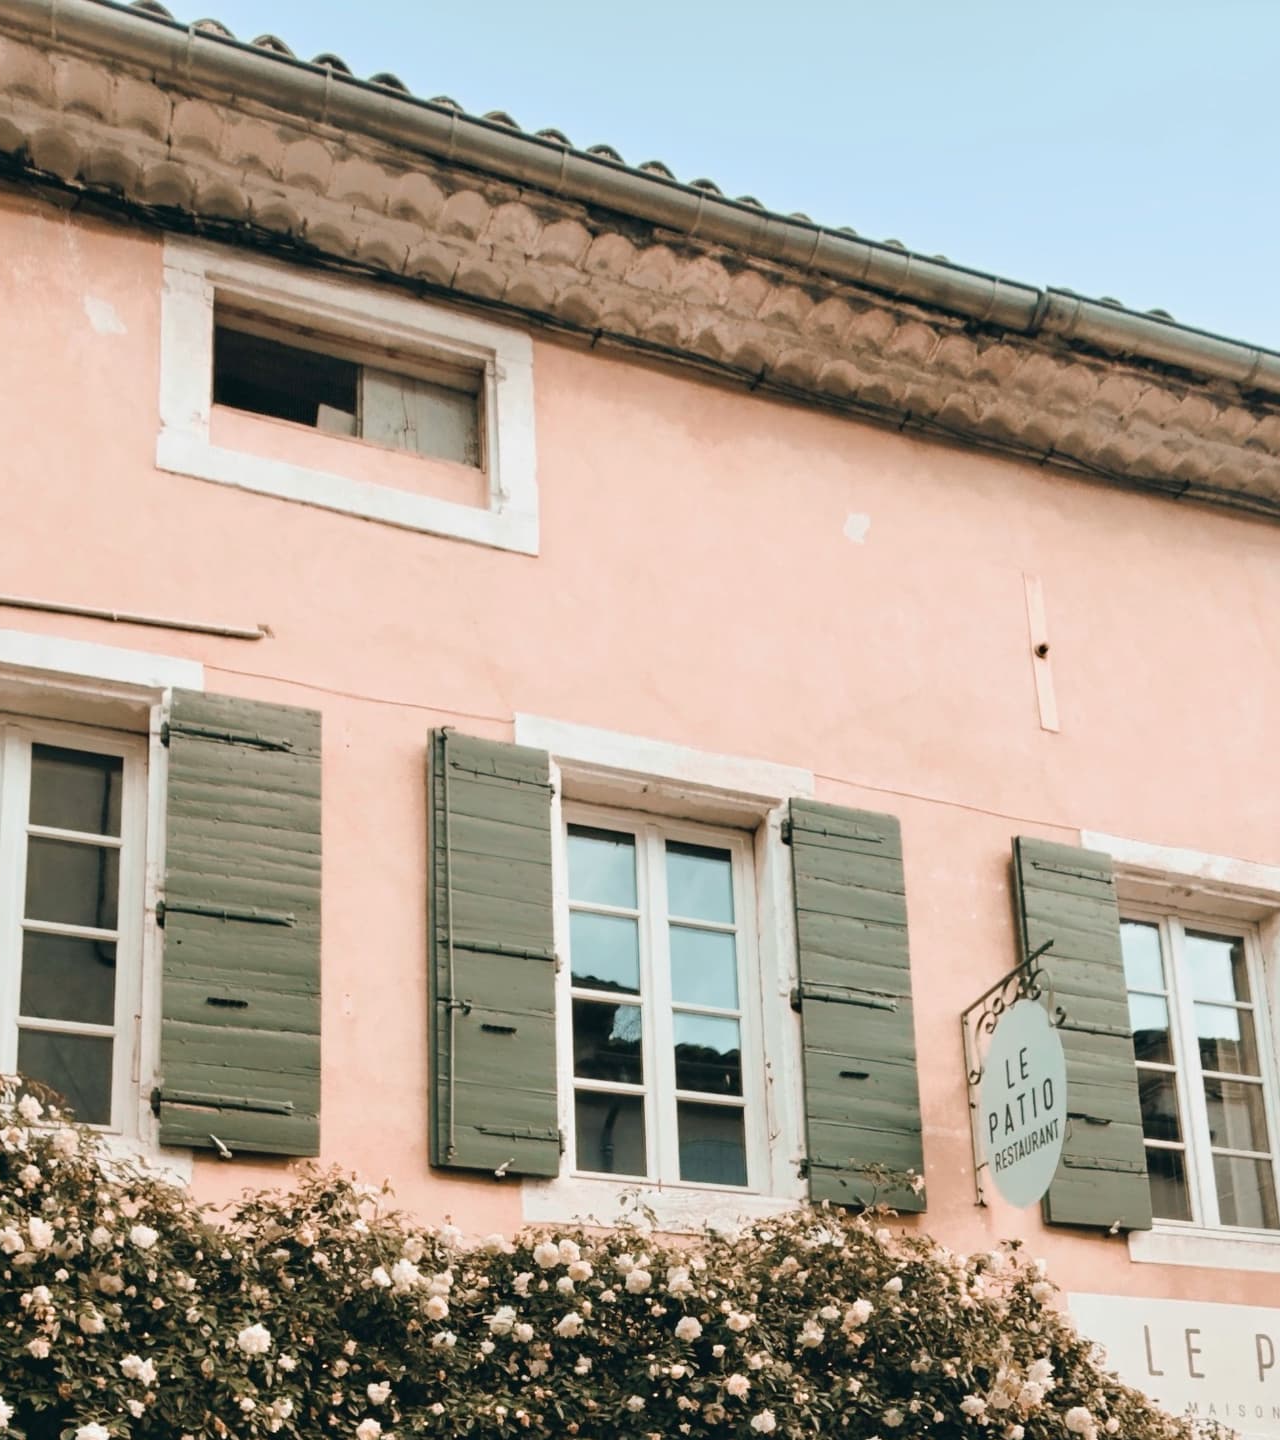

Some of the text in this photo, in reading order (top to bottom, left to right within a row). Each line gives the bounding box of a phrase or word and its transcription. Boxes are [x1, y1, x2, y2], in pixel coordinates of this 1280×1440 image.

[1005, 1047, 1029, 1089] LE
[988, 1077, 1054, 1144] PATIO
[994, 1118, 1059, 1173] RESTAURANT
[1143, 1325, 1205, 1379] LE
